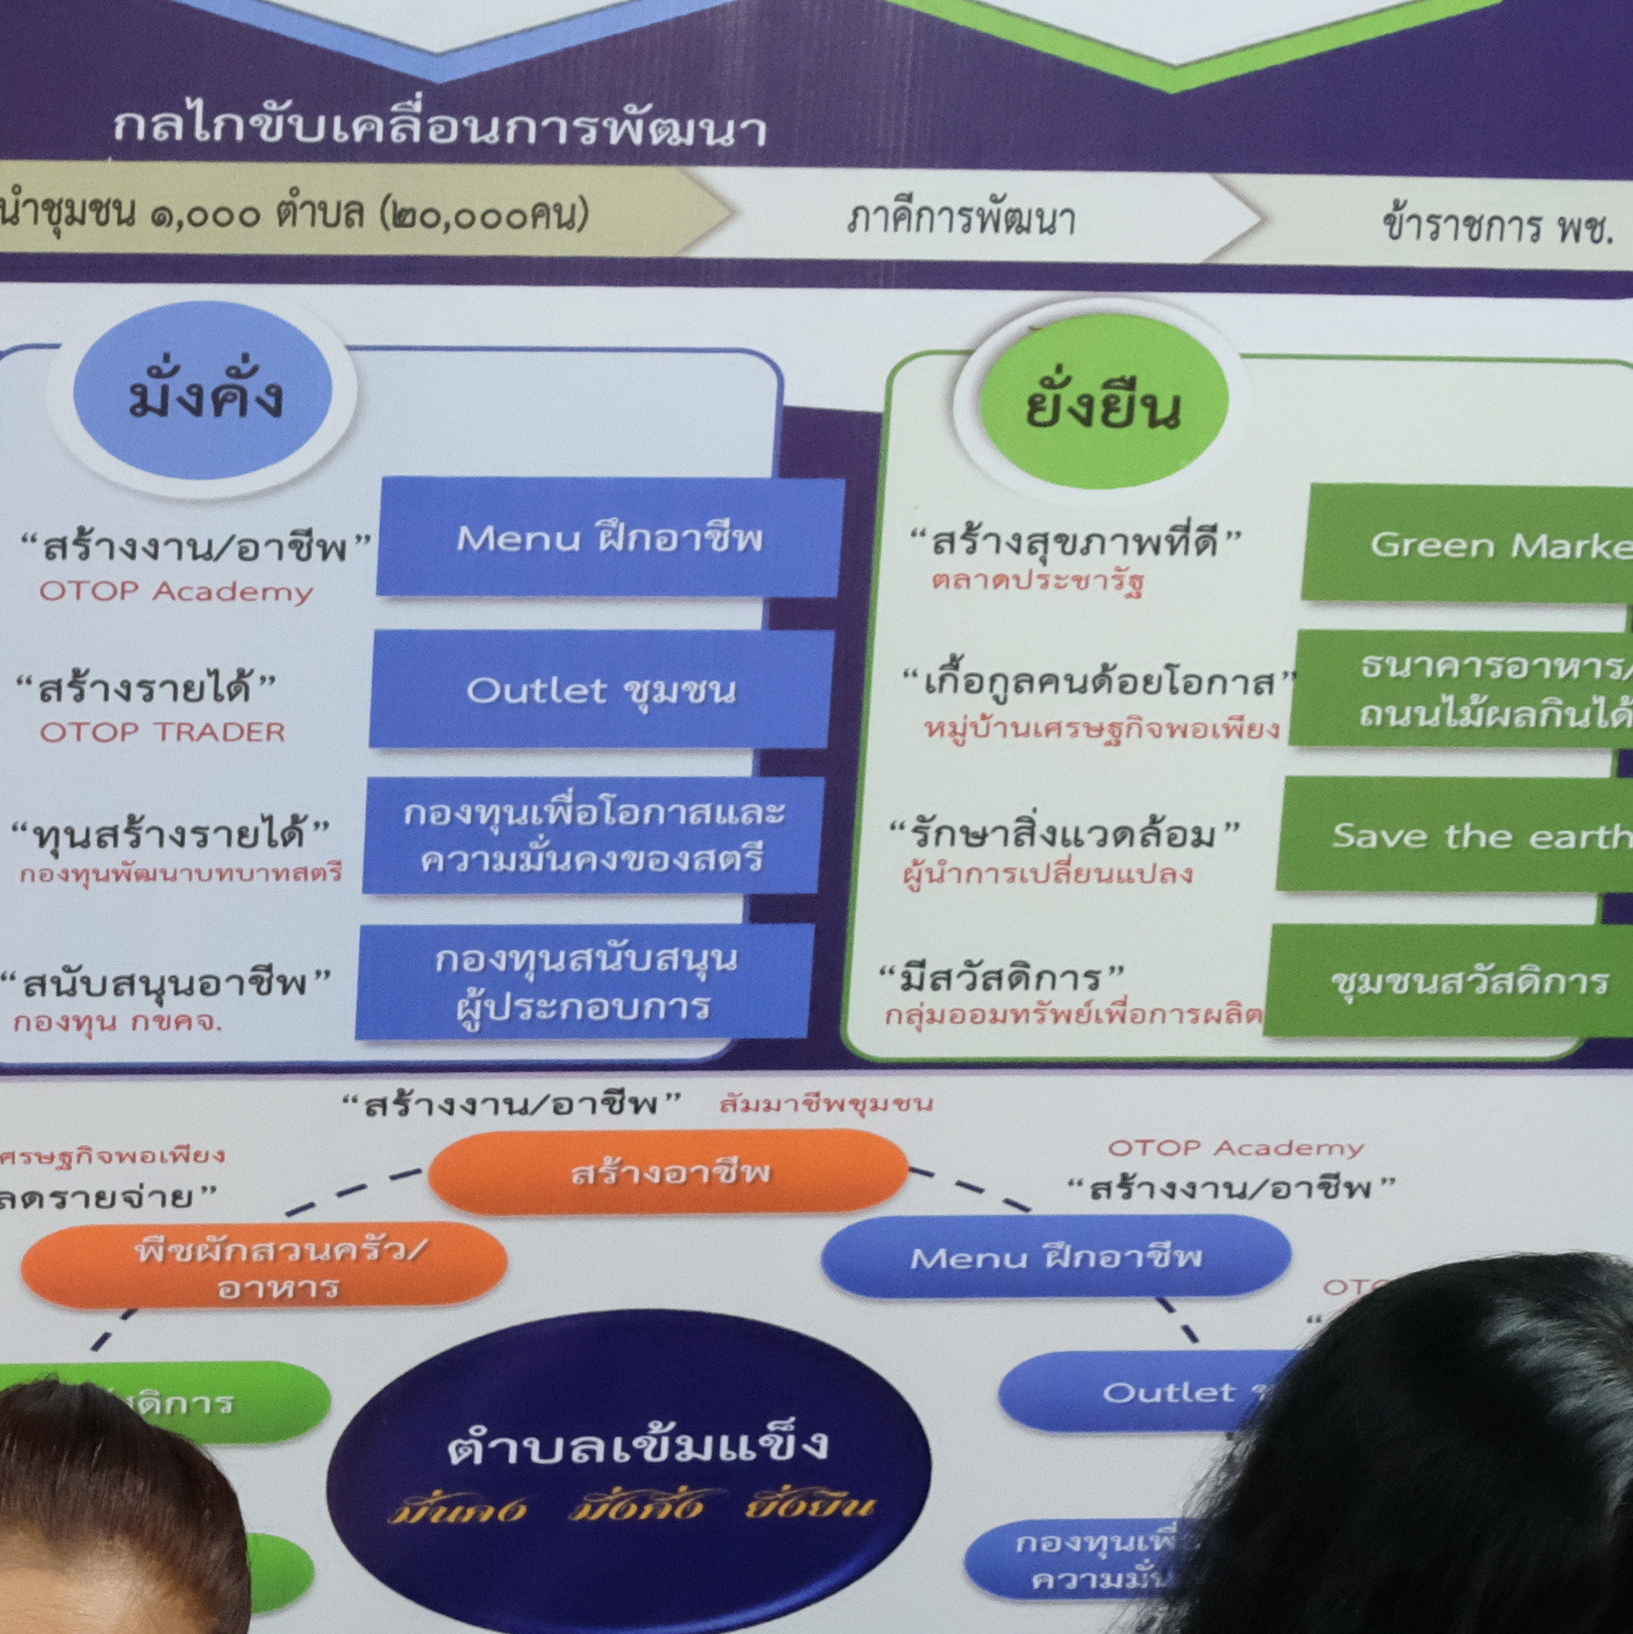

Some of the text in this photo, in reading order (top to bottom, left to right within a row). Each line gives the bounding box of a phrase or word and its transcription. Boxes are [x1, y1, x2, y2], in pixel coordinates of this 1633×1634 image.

[114, 90, 767, 148] กลไกขับเคลื่อนการพัฒนา
[150, 205, 261, 233] ๑,๐๐๐
[276, 190, 365, 229] ตำบล
[379, 192, 589, 235] (๒๐,๐๐๐คน)
[847, 191, 1076, 236] ภาคีการพัฒนา
[1382, 197, 1614, 245] ข้าราชการ พช.
[129, 352, 285, 420] มั่งคั่ง
[1026, 363, 1182, 430] ยั่งยืน
[20, 524, 372, 563] “สร้างงาน/อาชีพ”
[457, 516, 763, 553] Menu ฝึกอาชีพ
[910, 516, 1242, 567] “สร้างสุขภาพที่ดี”
[1371, 531, 1495, 558] Green
[39, 579, 314, 607] OTOP Academy
[931, 566, 1145, 600] ตลาดประชารัฐ
[16, 667, 276, 704] “สร้างรายได้”
[466, 675, 737, 715] Outlet ชุมชน
[902, 651, 1299, 707] “เกื้อกูลคนด้อยโอกาส”
[39, 721, 285, 744] OTOP TRADER
[923, 712, 1281, 748] หมู่บ้านเศรษฐกิจพอเพียง
[11, 812, 330, 858] “ทุนสร้างรายได้”
[404, 793, 786, 840] กองทุนเพื่อโอกาสและ
[889, 806, 1240, 849] “รักษาสิ่งแวดล้อม”
[1332, 822, 1633, 850] Save the earth
[421, 831, 764, 873] ความมั่นคงของสตรี
[20, 857, 343, 891] กองทุนพัฒนาบทบาทสตรี
[902, 855, 1194, 894] ผู้นำการเปลี่ยนแปลง
[436, 938, 738, 984] กองทุนสนับสนุน
[879, 958, 1128, 998] “มีสวัสดิการ”
[0, 962, 331, 1009] “สนับสนุนอาชีพ”
[1331, 962, 1611, 1005] ชุมชนสวัสดิการ
[13, 1009, 222, 1041] กองทุน กขคจ.
[456, 986, 712, 1033] ผู้ประกอบการ
[885, 998, 1265, 1034] กลุ่มออมทรัพย์เพื่อการผลิต
[342, 1086, 934, 1119] “สร้างงาน/อาชีพ” สัมมาชีพชุมชน
[1107, 1138, 1365, 1160] OTOP Academy
[571, 1154, 773, 1187] สร้างอาชีพ
[1067, 1171, 1396, 1201] “สร้างงาน/อาชีพ”
[133, 1232, 429, 1264] พืชผักสวนครัว/
[910, 1240, 1203, 1270] Menu ฝึกอาชีพ
[217, 1279, 340, 1300] อาหาร
[1103, 1381, 1236, 1404] Outlet
[447, 1416, 829, 1466] ตำบลเข้มแข็ง
